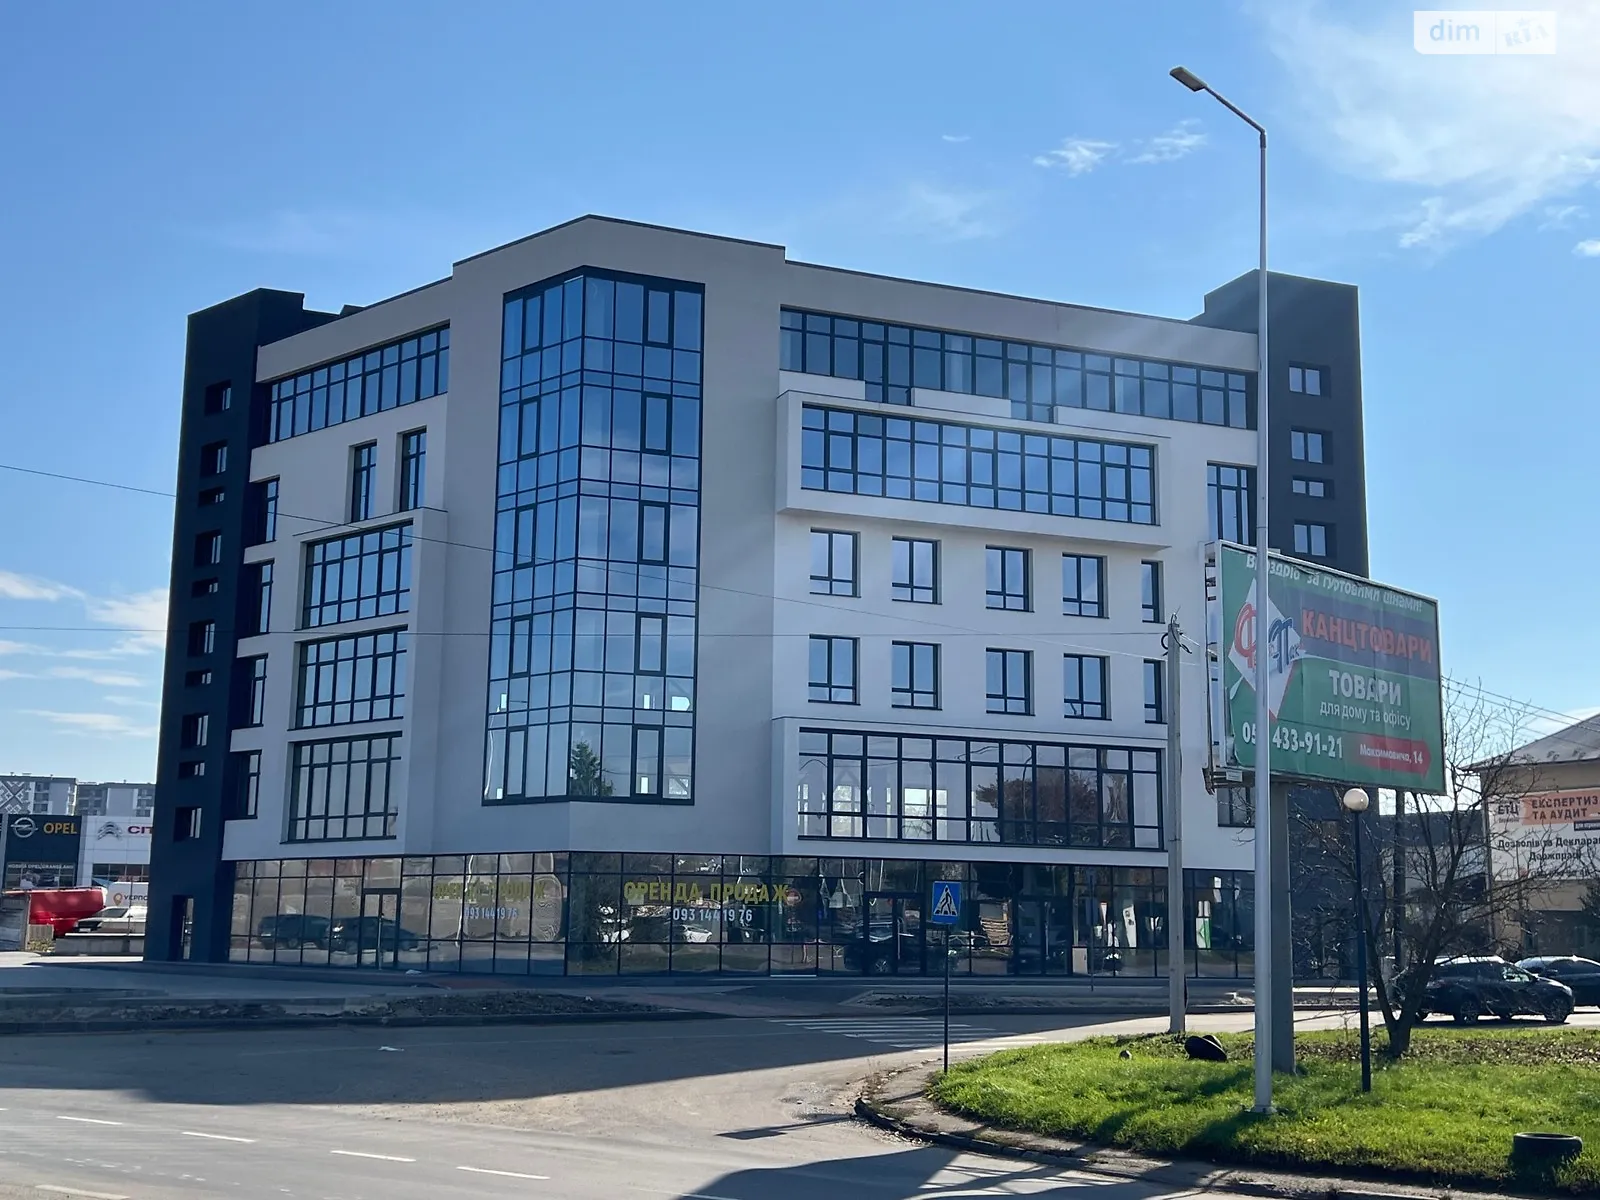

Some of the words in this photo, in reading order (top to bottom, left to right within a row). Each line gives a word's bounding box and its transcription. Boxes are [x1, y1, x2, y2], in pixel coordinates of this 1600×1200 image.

[1302, 608, 1432, 664] КАНЦТОВАРИ
[1328, 669, 1401, 706] ТОВАРИ
[1320, 701, 1340, 717] для
[1341, 705, 1367, 724] дому
[1370, 709, 1381, 722] та
[1383, 710, 1411, 731] офісу
[1272, 726, 1343, 759] 433-91-21
[1413, 750, 1423, 764] 14
[1532, 810, 1546, 820] ТА
[1550, 808, 1587, 821] АУДИТ
[43, 822, 78, 834] OPEL
[623, 882, 701, 903] ОРЕНДА
[673, 908, 695, 921] 093
[699, 909, 720, 922] 144
[723, 909, 735, 921] 19
[739, 909, 752, 922] 76
